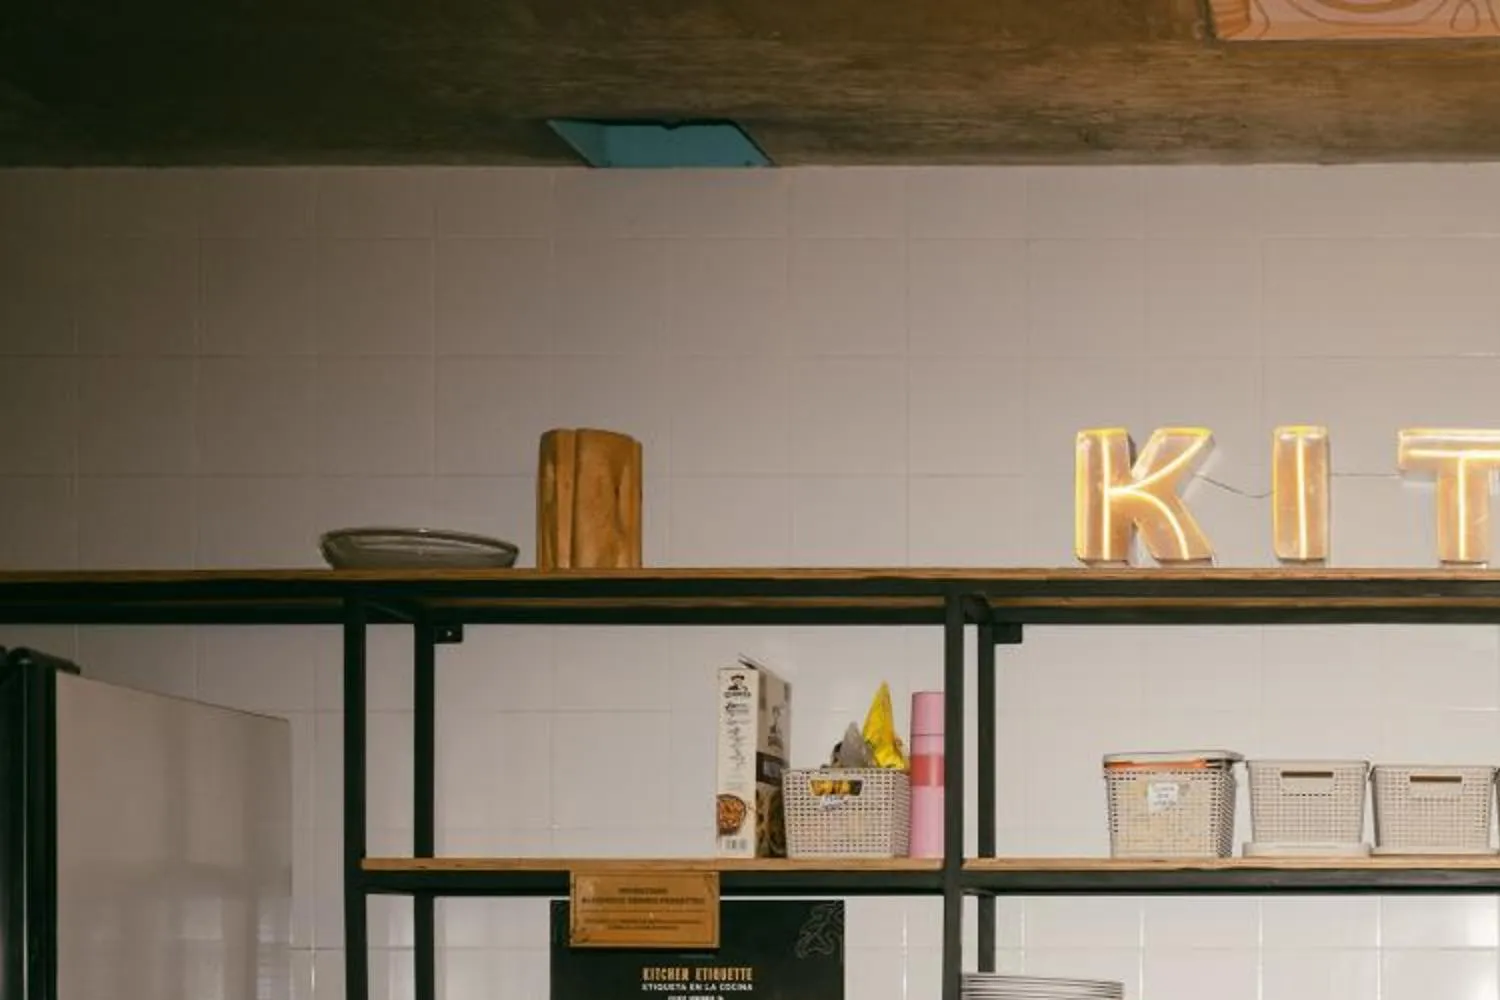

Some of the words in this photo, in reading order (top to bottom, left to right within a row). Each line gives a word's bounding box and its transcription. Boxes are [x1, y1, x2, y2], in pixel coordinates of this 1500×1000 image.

[643, 967, 689, 981] KITCHEN
[695, 967, 753, 981] ETIQUETTE
[641, 983, 687, 991] ETIQUETA
[689, 983, 703, 991] EN
[705, 983, 718, 991] LA
[719, 983, 753, 991] COCINA
